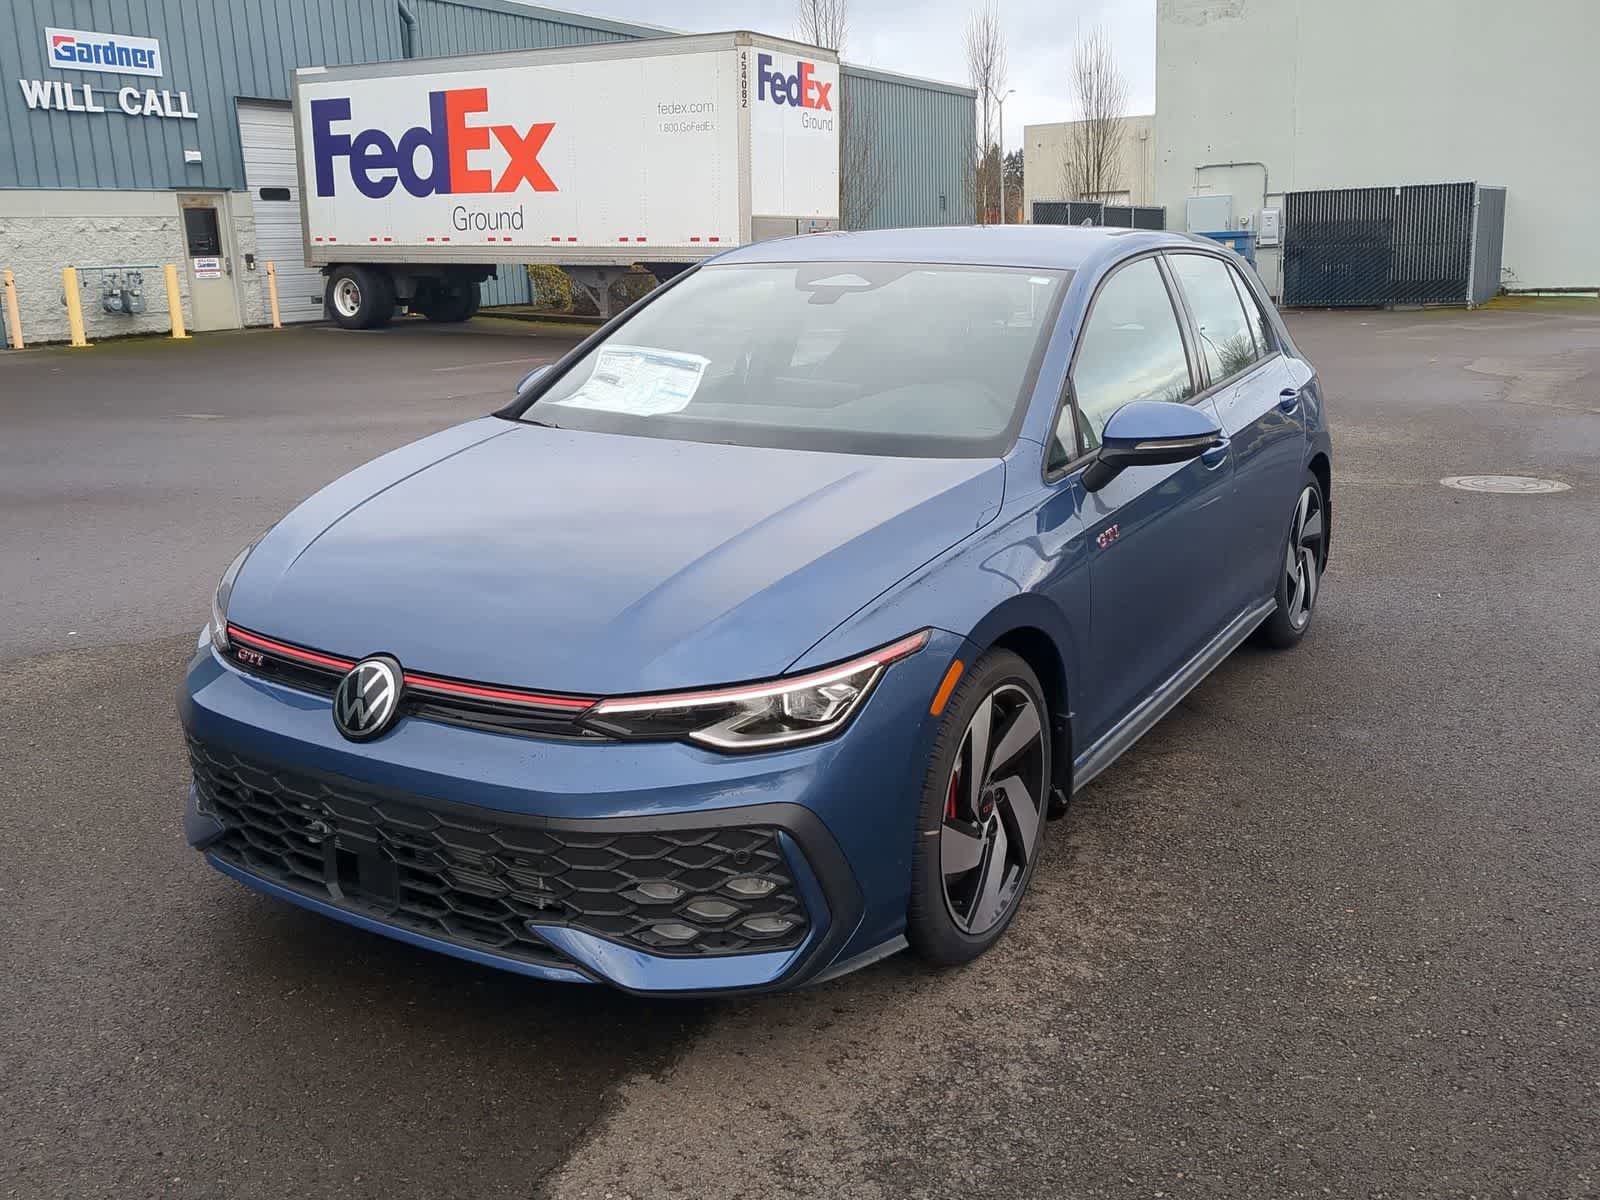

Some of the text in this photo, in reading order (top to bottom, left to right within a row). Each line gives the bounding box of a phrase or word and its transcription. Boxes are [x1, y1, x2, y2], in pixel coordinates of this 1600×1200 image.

[52, 35, 156, 69] Gardner
[740, 51, 749, 109] 454082
[757, 53, 833, 112] FedEx
[19, 79, 199, 119] WILL CALL
[657, 101, 715, 115] fedex.com
[801, 111, 834, 131] Ground
[310, 87, 559, 199] FedEx
[452, 204, 525, 232] Ground
[237, 648, 264, 667] GTI
